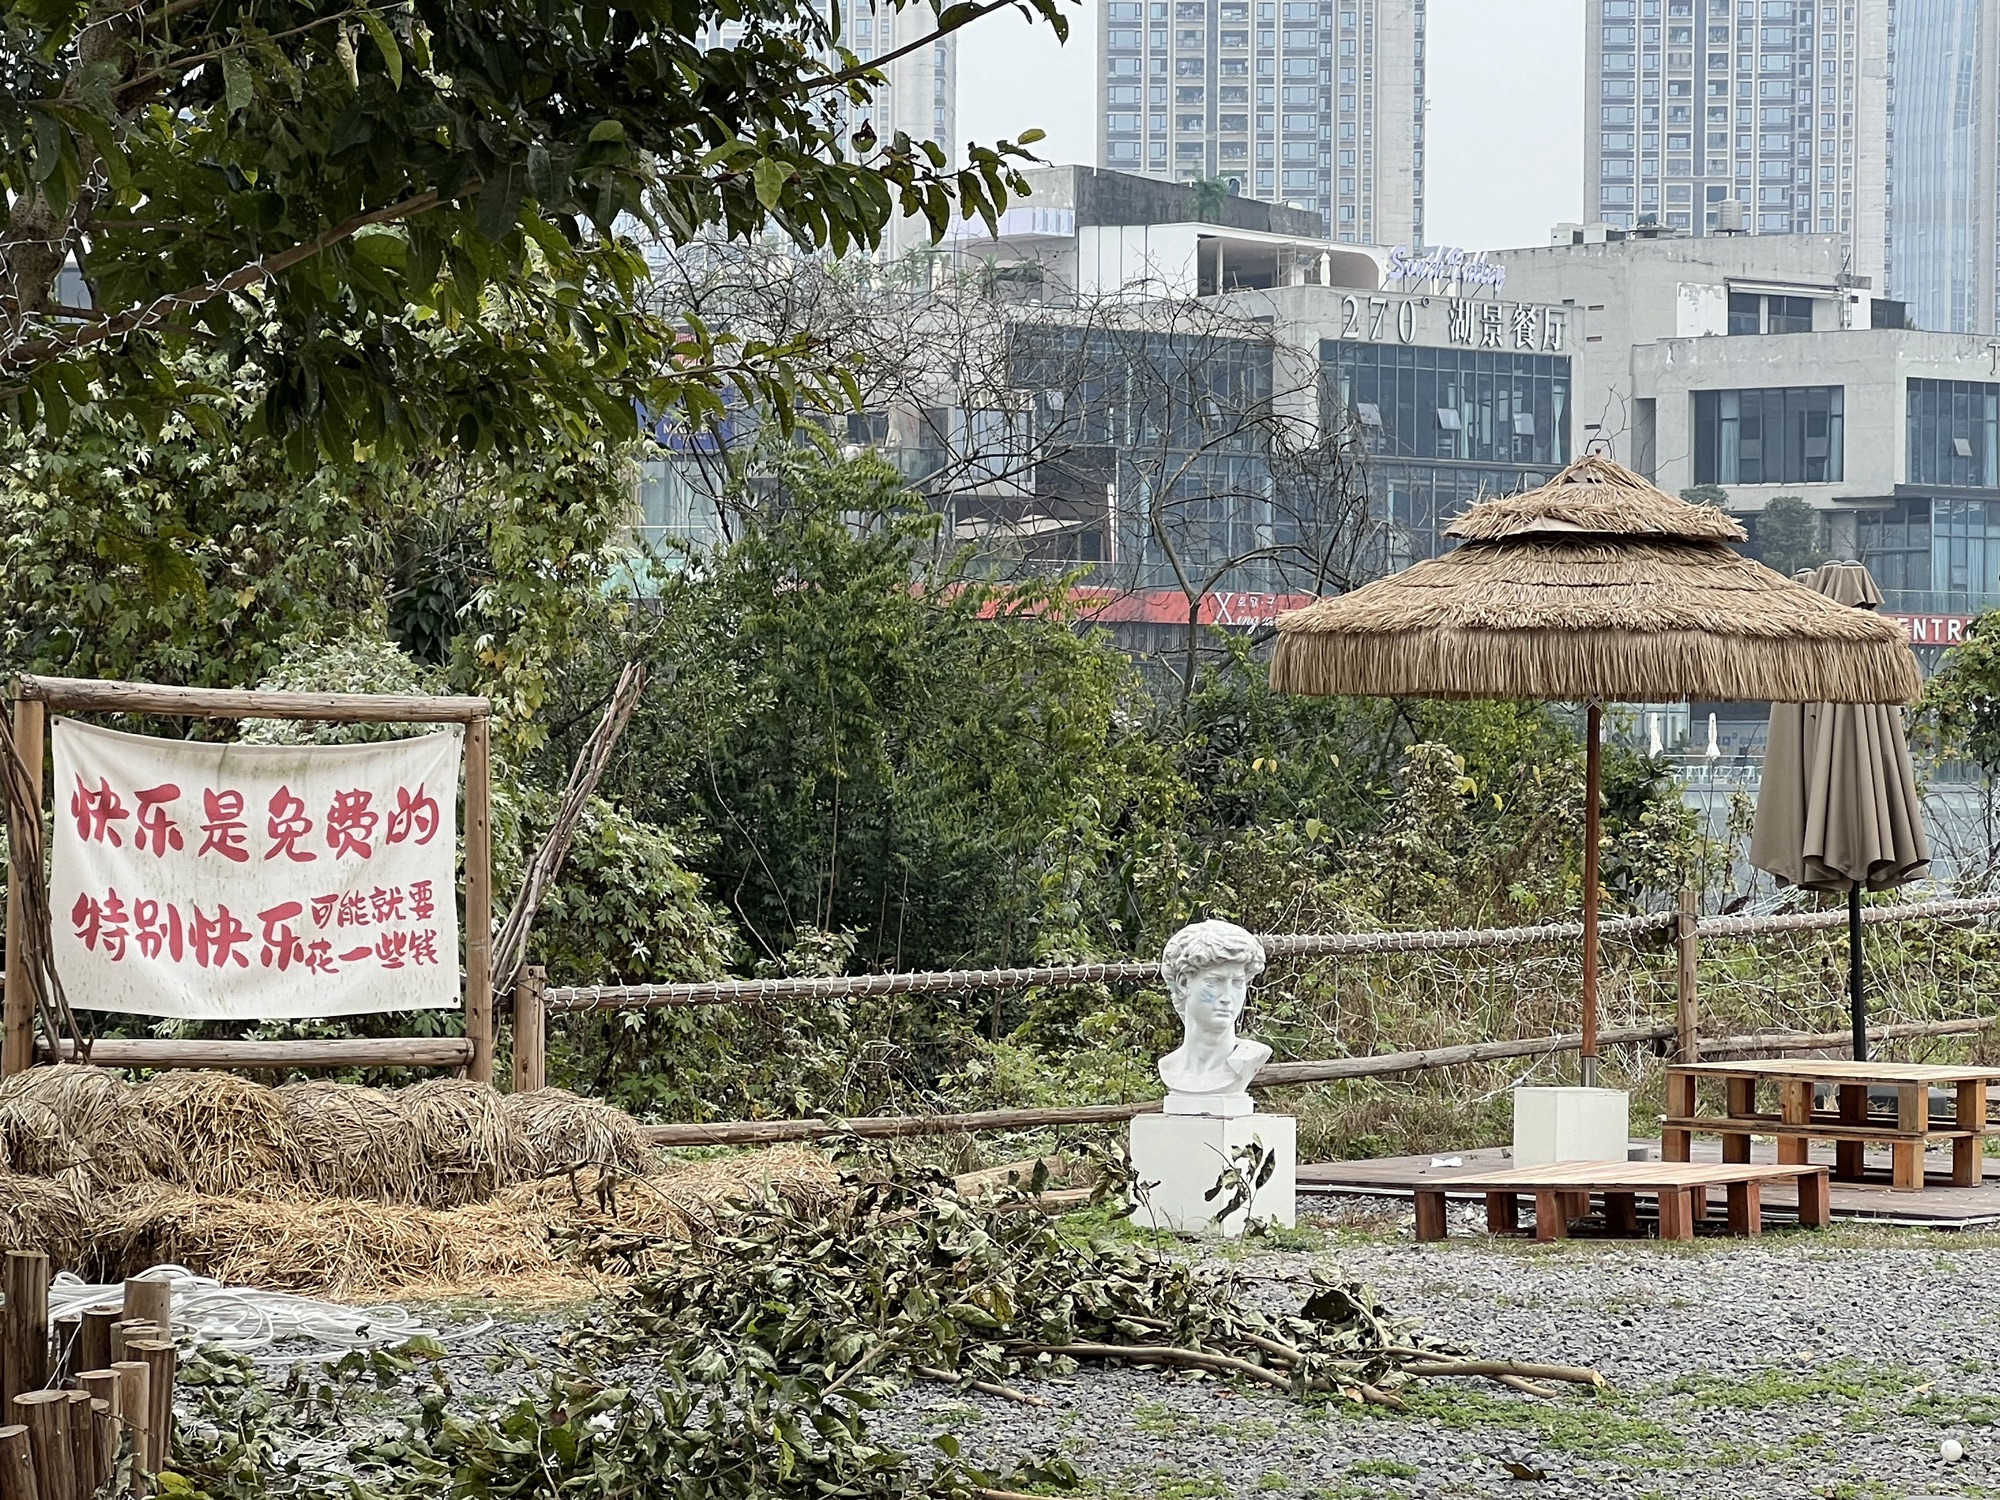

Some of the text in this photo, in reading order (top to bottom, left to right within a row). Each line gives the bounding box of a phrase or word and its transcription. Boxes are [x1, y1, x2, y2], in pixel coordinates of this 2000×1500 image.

[1450, 297, 1567, 352] 湖景餐厅
[71, 773, 439, 863] 快乐是免费的
[71, 887, 304, 972] 特别快乐
[310, 879, 434, 929] 可能就要
[305, 928, 438, 975] 花一些钱
